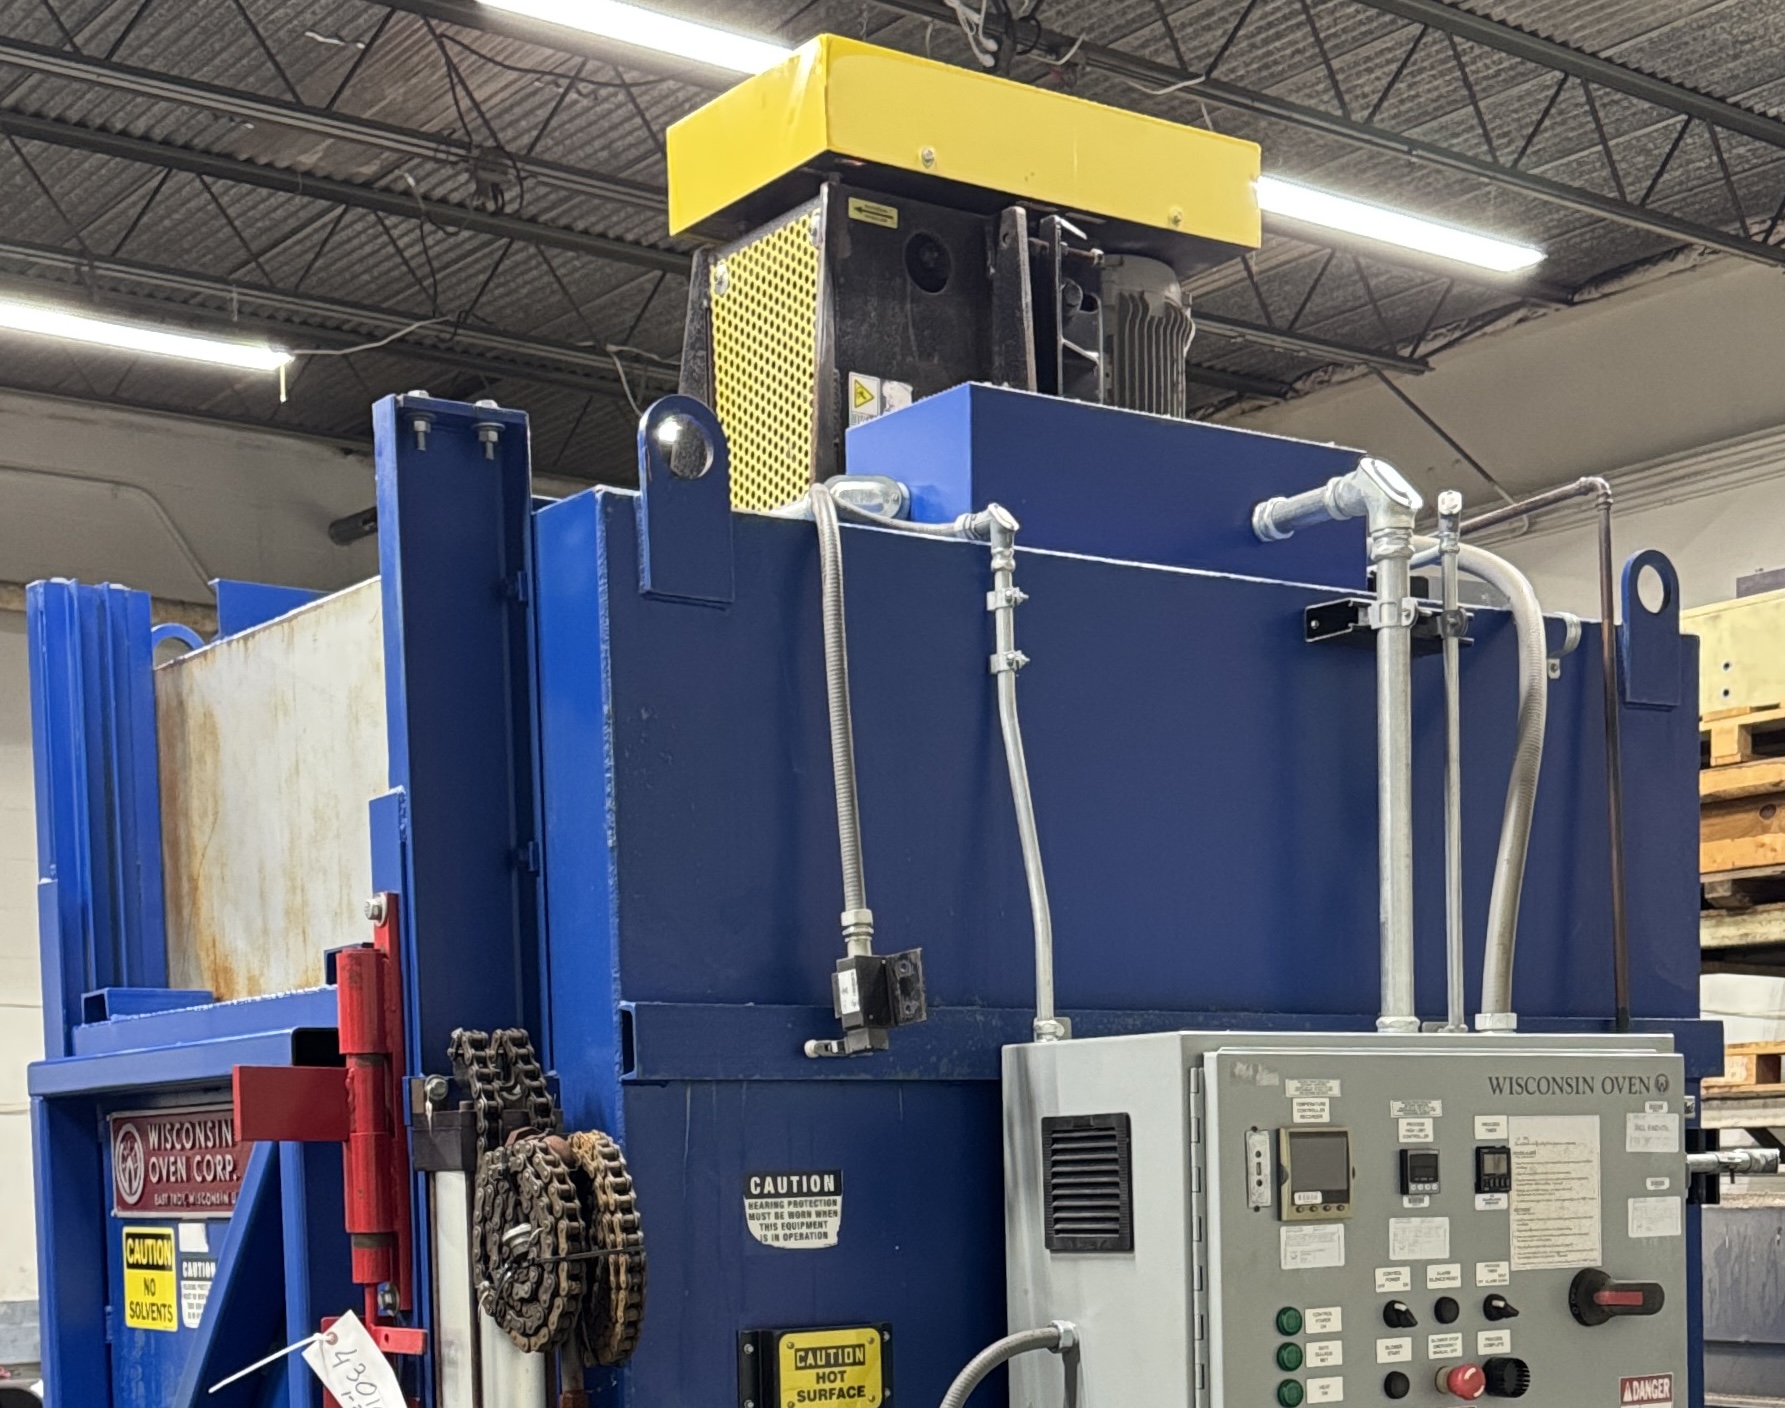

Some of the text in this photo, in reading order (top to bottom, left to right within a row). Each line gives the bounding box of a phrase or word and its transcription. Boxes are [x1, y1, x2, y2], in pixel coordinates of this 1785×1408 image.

[1488, 1076, 1651, 1095] WISCONSIN OVEN
[148, 1120, 233, 1150] WISCONSIN
[149, 1154, 238, 1183] OVEN CORP.
[750, 1174, 835, 1195] CAUTION
[189, 1192, 229, 1206] WISCONSIN
[748, 1198, 838, 1211] HEARING PROTECTION
[748, 1209, 838, 1221] MUST BE WORN WHEN
[759, 1220, 828, 1231] THIS EQUIPMENT
[771, 1232, 780, 1241] IN
[783, 1231, 828, 1241] OPERATION
[126, 1238, 172, 1267] CAUTION
[143, 1278, 156, 1296] NO
[129, 1302, 173, 1323] SOLVENTS
[797, 1347, 865, 1367] CAUTION
[816, 1370, 847, 1385] HOT
[797, 1385, 866, 1402] SURFACE
[1632, 1378, 1670, 1401] DANGER
